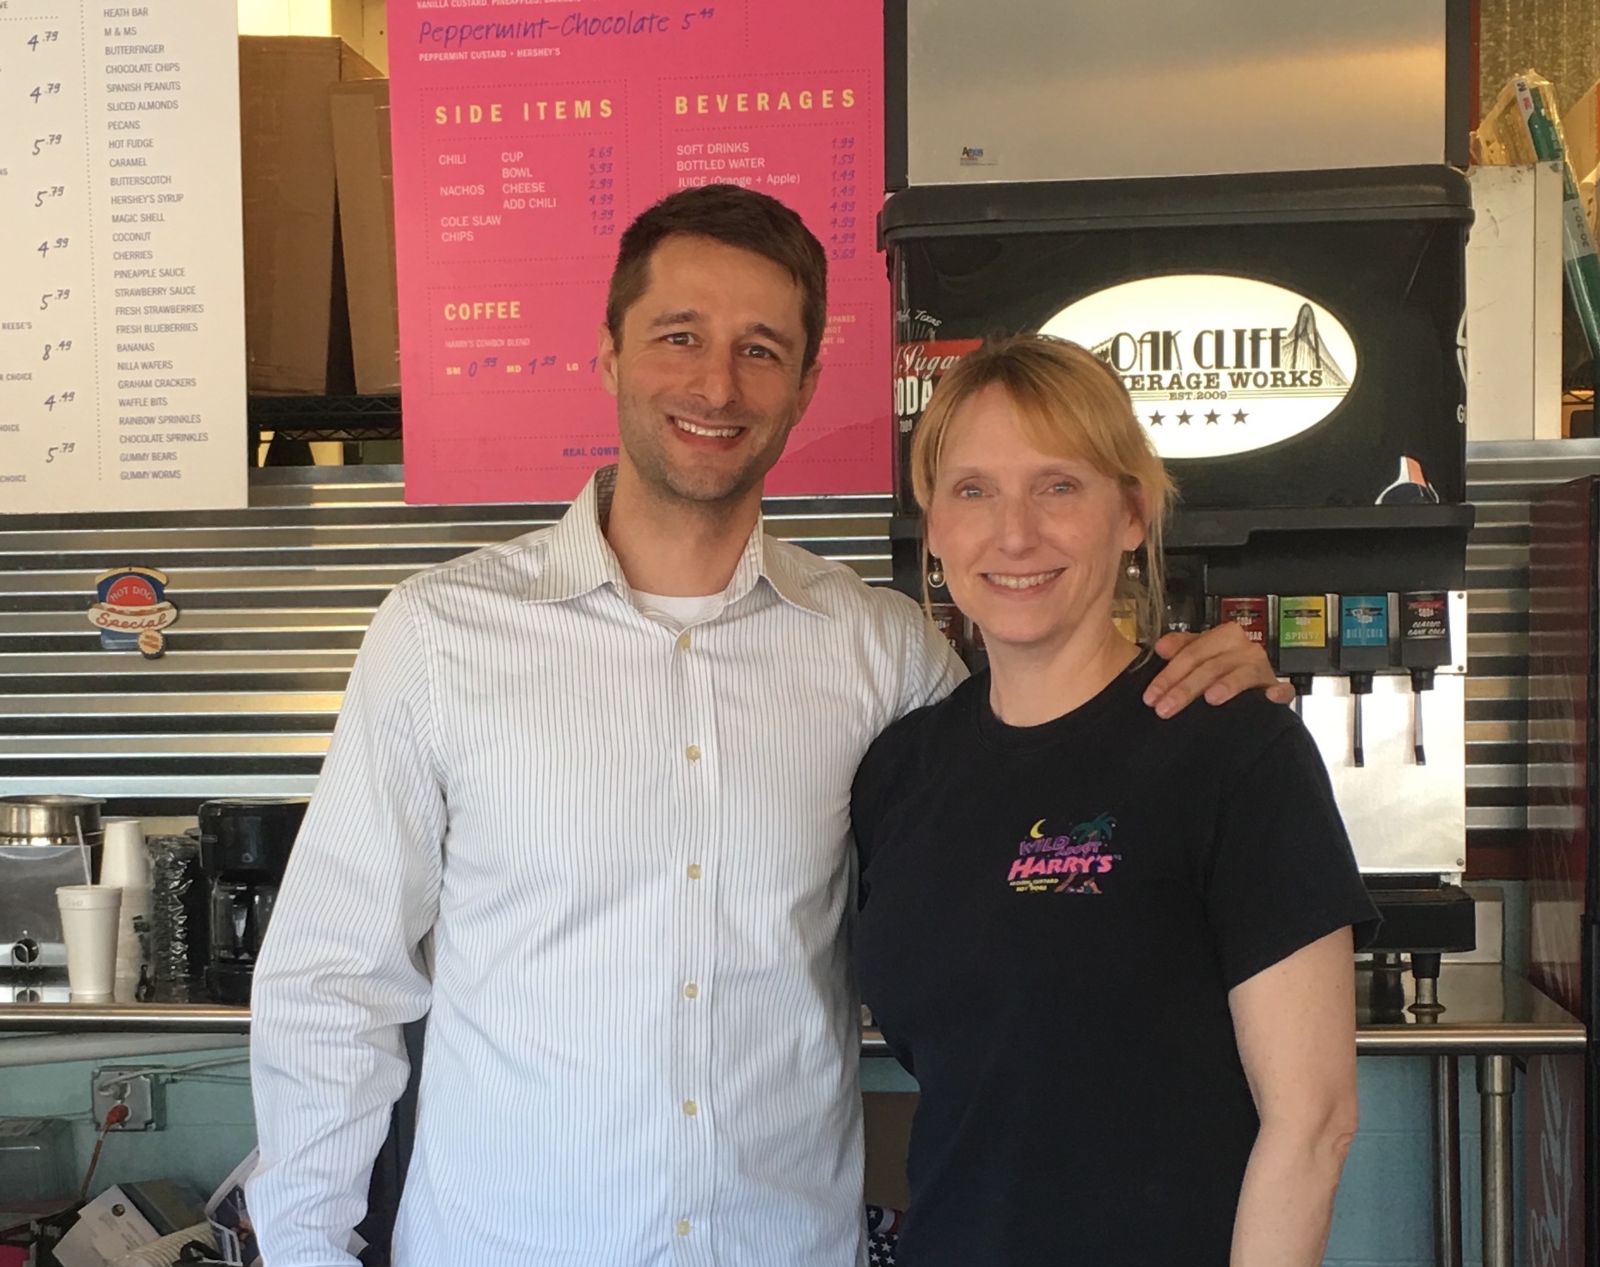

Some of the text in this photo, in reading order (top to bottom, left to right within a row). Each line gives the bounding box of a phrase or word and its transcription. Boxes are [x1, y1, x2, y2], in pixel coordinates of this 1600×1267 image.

[104, 8, 148, 17] HEATH BAR
[104, 27, 136, 36] M & MS
[419, 10, 670, 48] Peppermint-Chocolate
[105, 44, 164, 55] BUTTERFINGER
[419, 48, 560, 62] PEPPERMINT CUSTARD HERSHEY'S
[106, 63, 180, 74] CHOCOLATE CHIPS
[106, 82, 181, 92] SPANISH PEANUTS
[107, 100, 178, 111] SLICED ALMONDS
[675, 88, 855, 115] BEVERAGES
[435, 99, 612, 124] SIDE ITEMS
[108, 120, 140, 130] PECANS
[109, 139, 154, 149] HOT FUDGE
[676, 142, 750, 156] SOFT DRINKS
[110, 158, 147, 168] CARAMEL
[438, 152, 524, 165] CHILI CUP
[676, 158, 765, 171] BOTTLED WATER
[502, 168, 532, 178] BOWL
[110, 176, 172, 186] BUTTERSCOTCH
[678, 176, 707, 187] JUICE
[710, 174, 751, 187] (Orange
[767, 172, 800, 185] Apple)
[440, 182, 546, 196] NACHOS CHEESE
[111, 194, 184, 204] HERSHEY'S SYRUP
[503, 198, 556, 210] ADD CHILI
[112, 213, 164, 223] MAGIC SHELL
[441, 216, 502, 227] COLE SLAW
[112, 232, 151, 242] COCONUT
[442, 231, 474, 242] CHIPS
[113, 250, 153, 260] CHERRIES
[114, 268, 184, 278] PINEAPPLE SAUCE
[115, 286, 196, 297] STRAWBERRY SAUCE
[116, 304, 204, 316] FRESH STRAWBERRIES
[444, 301, 521, 320] COFFEE
[2, 322, 32, 330] REESE'S
[116, 323, 198, 334] FRESH BLUEBERRIES
[117, 343, 154, 352] BANANAS
[507, 338, 530, 346] BLEND
[1110, 328, 1288, 372] OAK CLIFF
[118, 360, 173, 371] NILLA WAFERS
[506, 365, 521, 374] MD
[566, 363, 578, 372] LG
[6, 373, 32, 381] CHOICE
[446, 367, 461, 376] SM
[118, 378, 196, 389] GRAHAM CRACKERS
[1228, 371, 1323, 389] WORKS
[118, 398, 168, 407] WAFFLE BITS
[119, 414, 201, 426] RAINBOW SPRINKLES
[120, 432, 208, 444] CHOCOLATE SPRINKLES
[120, 452, 178, 462] GUMMY BEARS
[563, 448, 587, 456] REAL
[120, 470, 182, 480] GUMMY WORMS
[110, 586, 152, 601] HOT DOG
[96, 612, 167, 629] Special
[1020, 836, 1070, 856] WILD
[1008, 855, 1112, 881] HARRY'S
